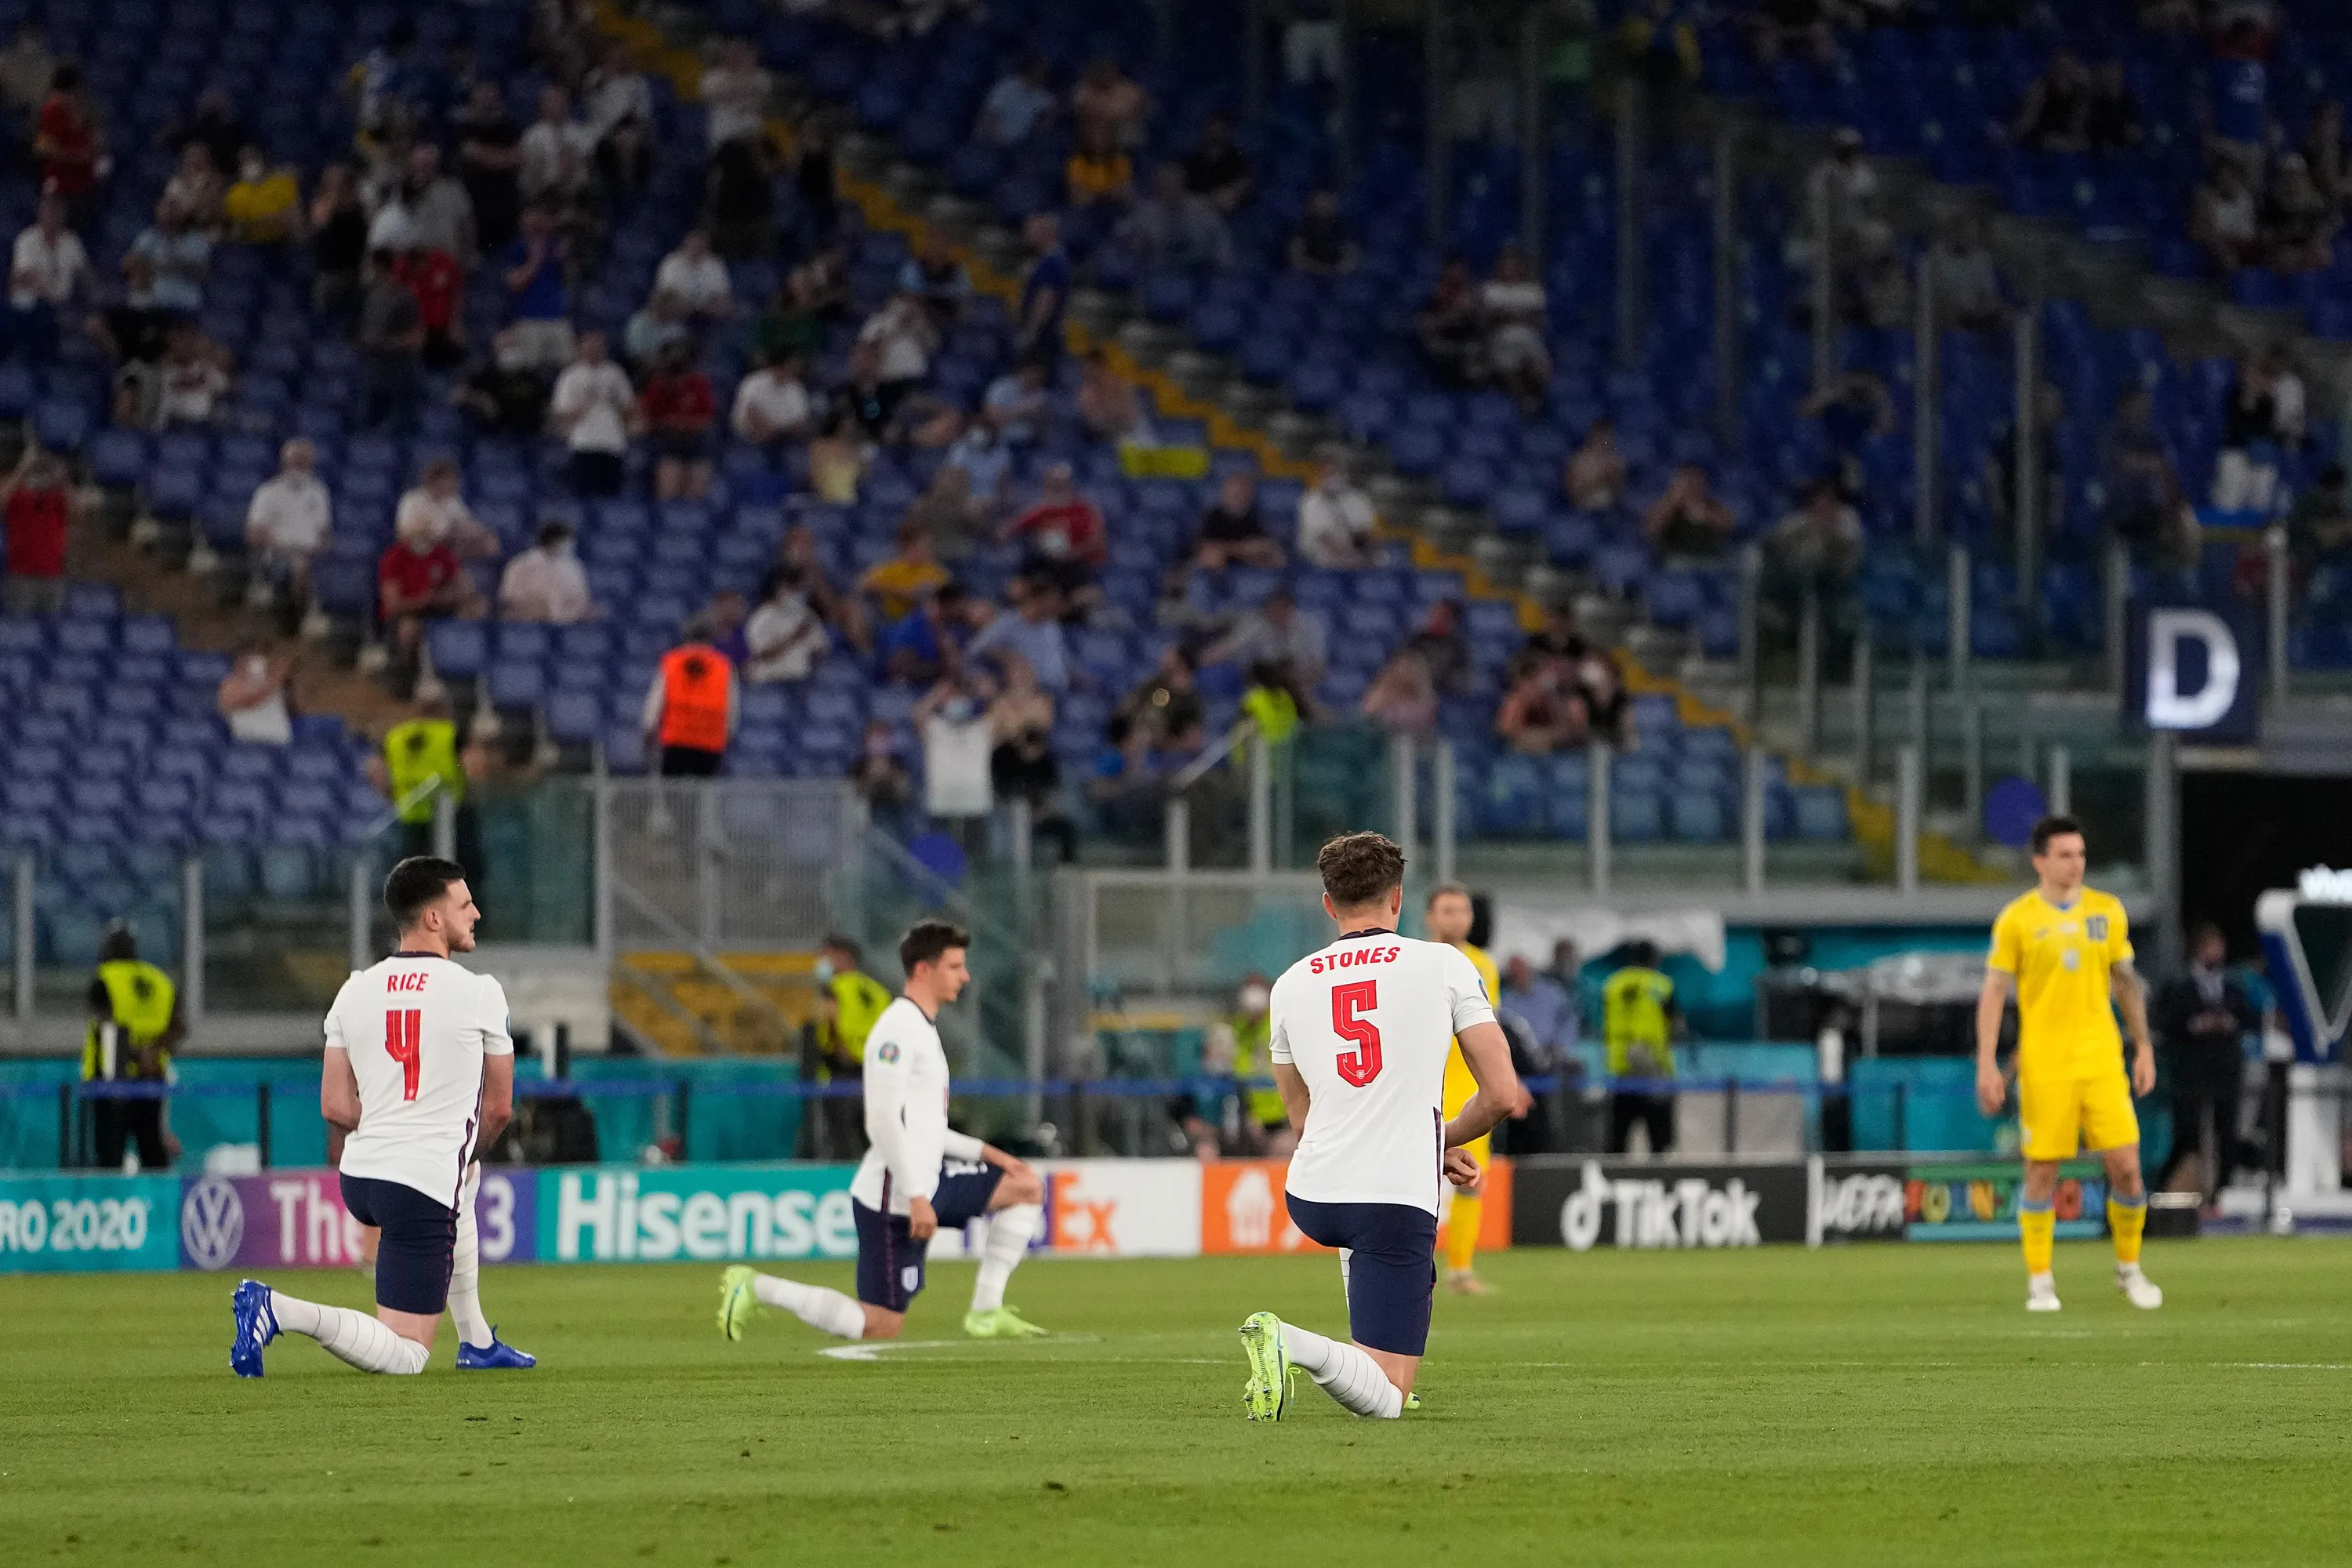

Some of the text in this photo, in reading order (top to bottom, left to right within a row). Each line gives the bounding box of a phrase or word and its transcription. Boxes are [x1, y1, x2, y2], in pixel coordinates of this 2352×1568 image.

[2147, 608, 2240, 729] D
[1310, 946, 1401, 975] STONES
[2085, 915, 2109, 942] 10
[387, 972, 429, 993] RICE
[384, 1008, 422, 1102] 4
[1331, 979, 1383, 1088] 5
[50, 1197, 147, 1250] 2020
[556, 1172, 860, 1261] Hisense
